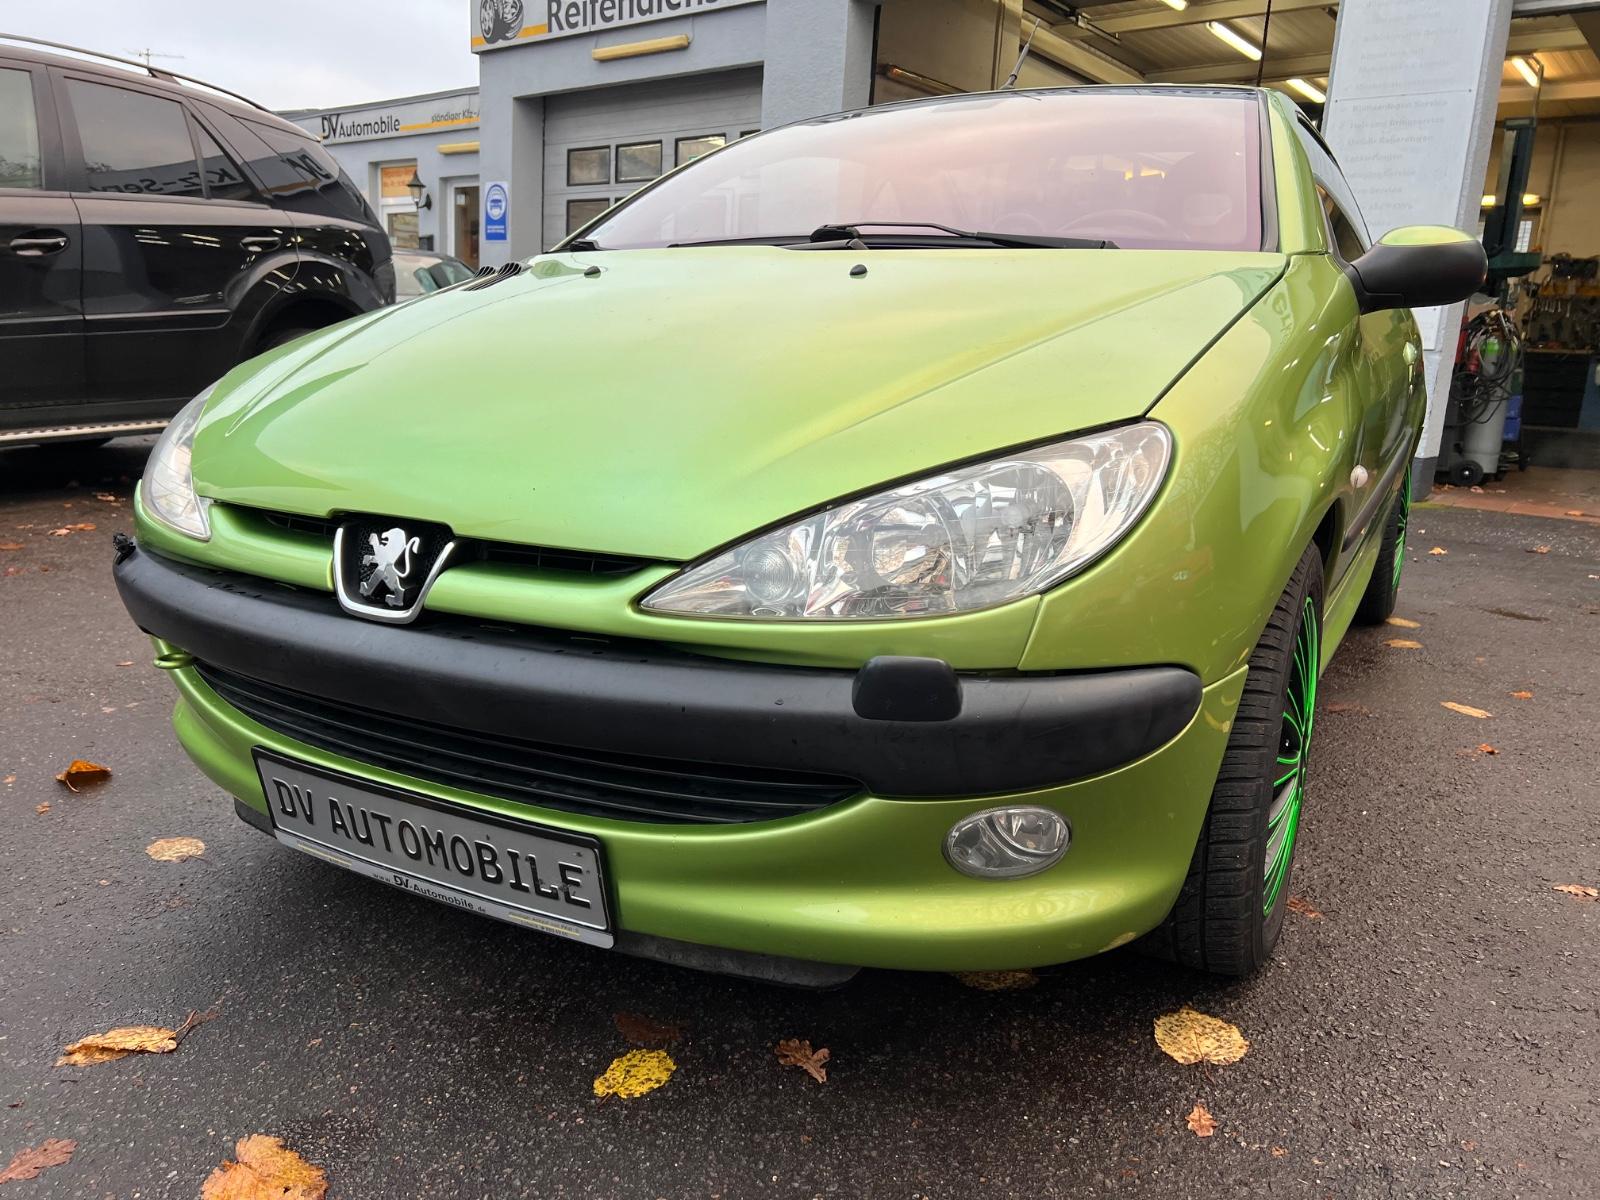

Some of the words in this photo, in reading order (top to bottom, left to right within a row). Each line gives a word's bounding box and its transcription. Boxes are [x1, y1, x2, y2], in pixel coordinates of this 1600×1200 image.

[547, 0, 718, 33] Reifen
[339, 115, 400, 138] Automobile
[272, 778, 314, 825] DV
[328, 797, 592, 909] AUTOMOBILE
